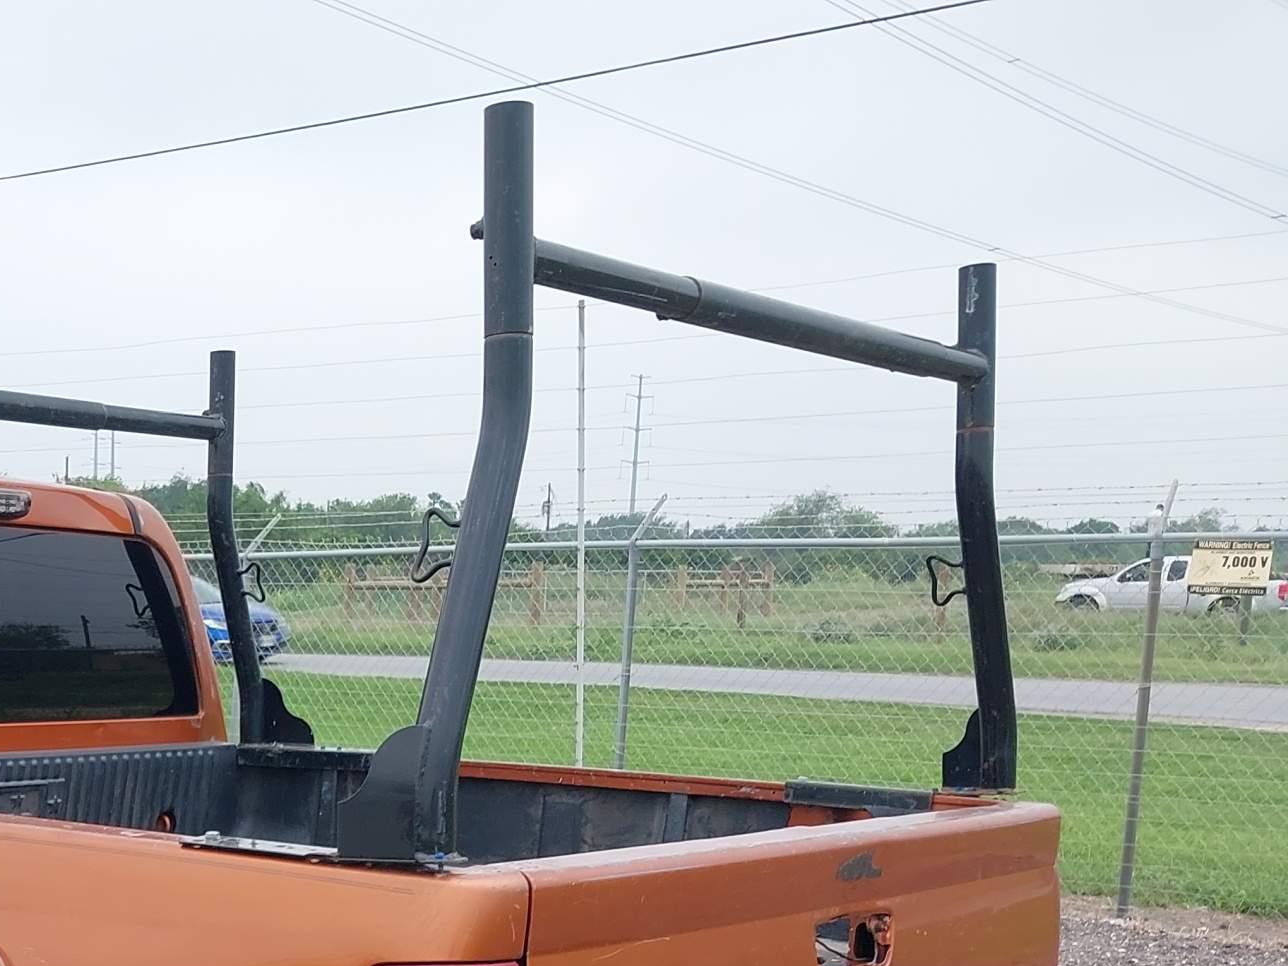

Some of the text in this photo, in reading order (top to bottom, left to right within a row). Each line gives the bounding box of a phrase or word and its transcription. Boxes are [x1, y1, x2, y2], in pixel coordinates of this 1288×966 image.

[1198, 540, 1270, 549] WARNING! Electric Fence
[1222, 556, 1269, 569] 7,000 V
